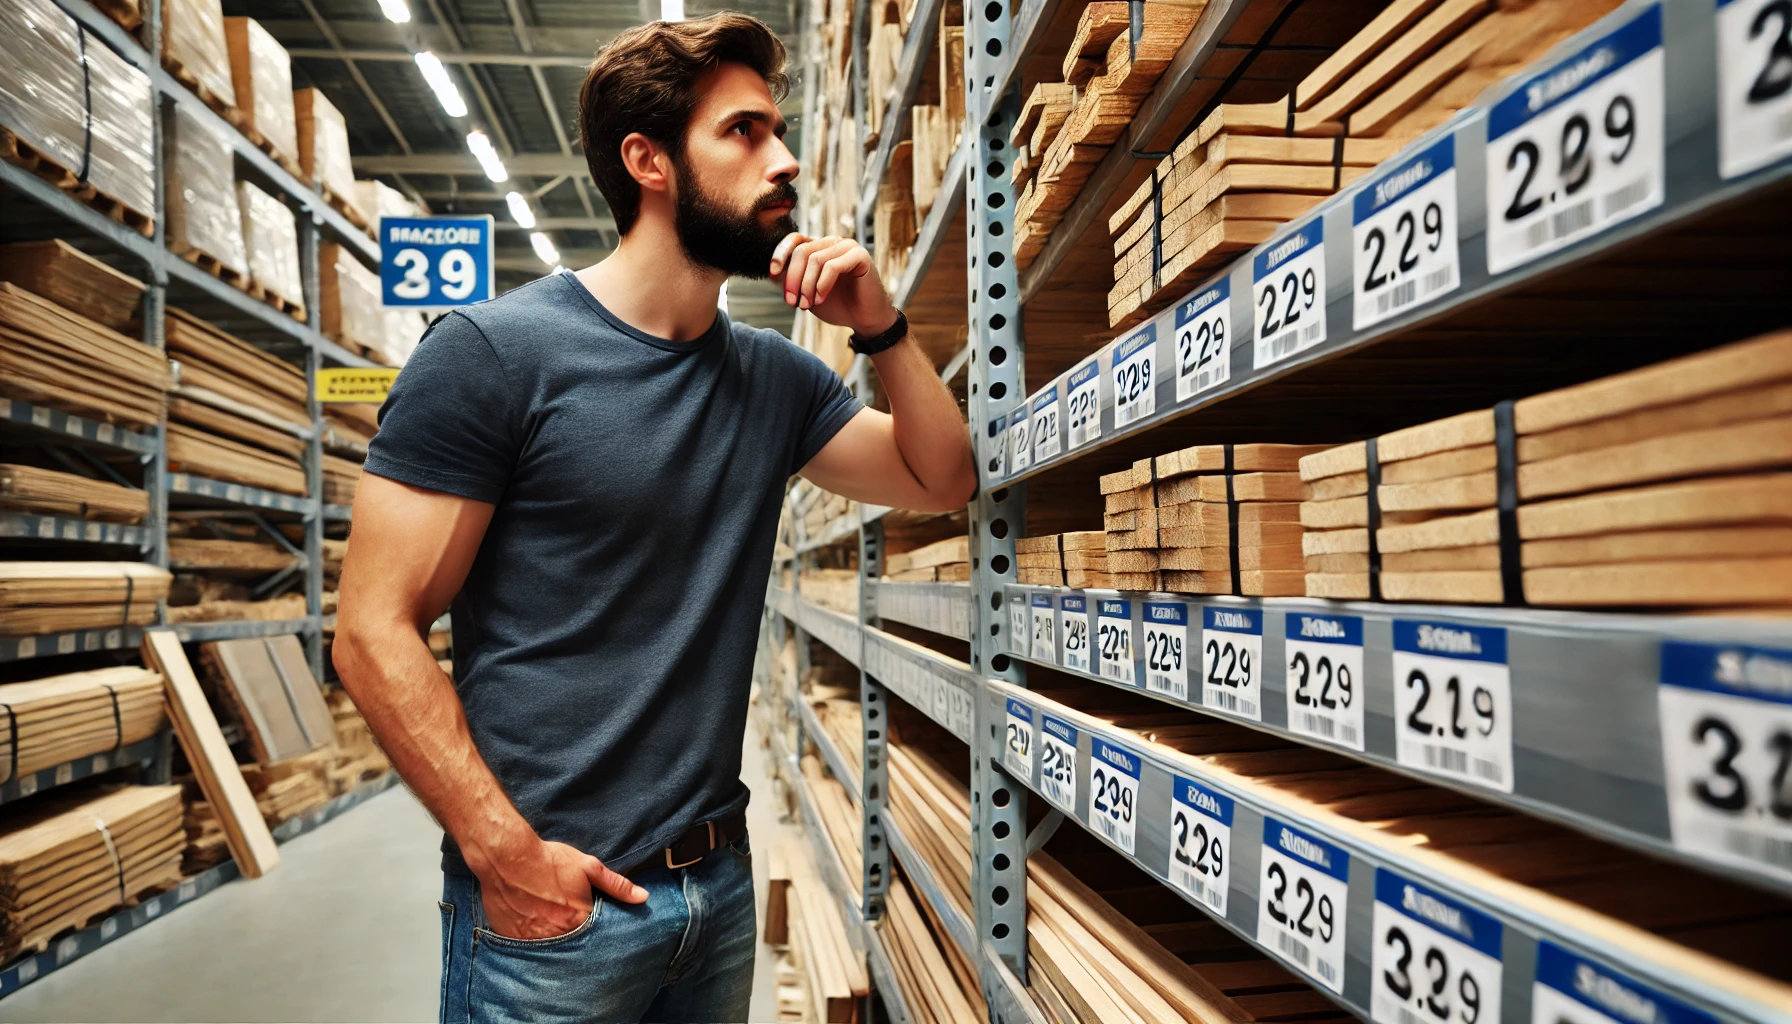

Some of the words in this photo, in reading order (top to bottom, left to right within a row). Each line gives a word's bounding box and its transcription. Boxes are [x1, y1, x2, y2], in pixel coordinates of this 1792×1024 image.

[1363, 202, 1443, 292] 2.29
[1180, 316, 1225, 377] 229
[1206, 639, 1251, 688] 229
[1290, 651, 1352, 709] 2.29
[1268, 861, 1333, 943] 3.29
[1384, 925, 1480, 1024] 3.29
